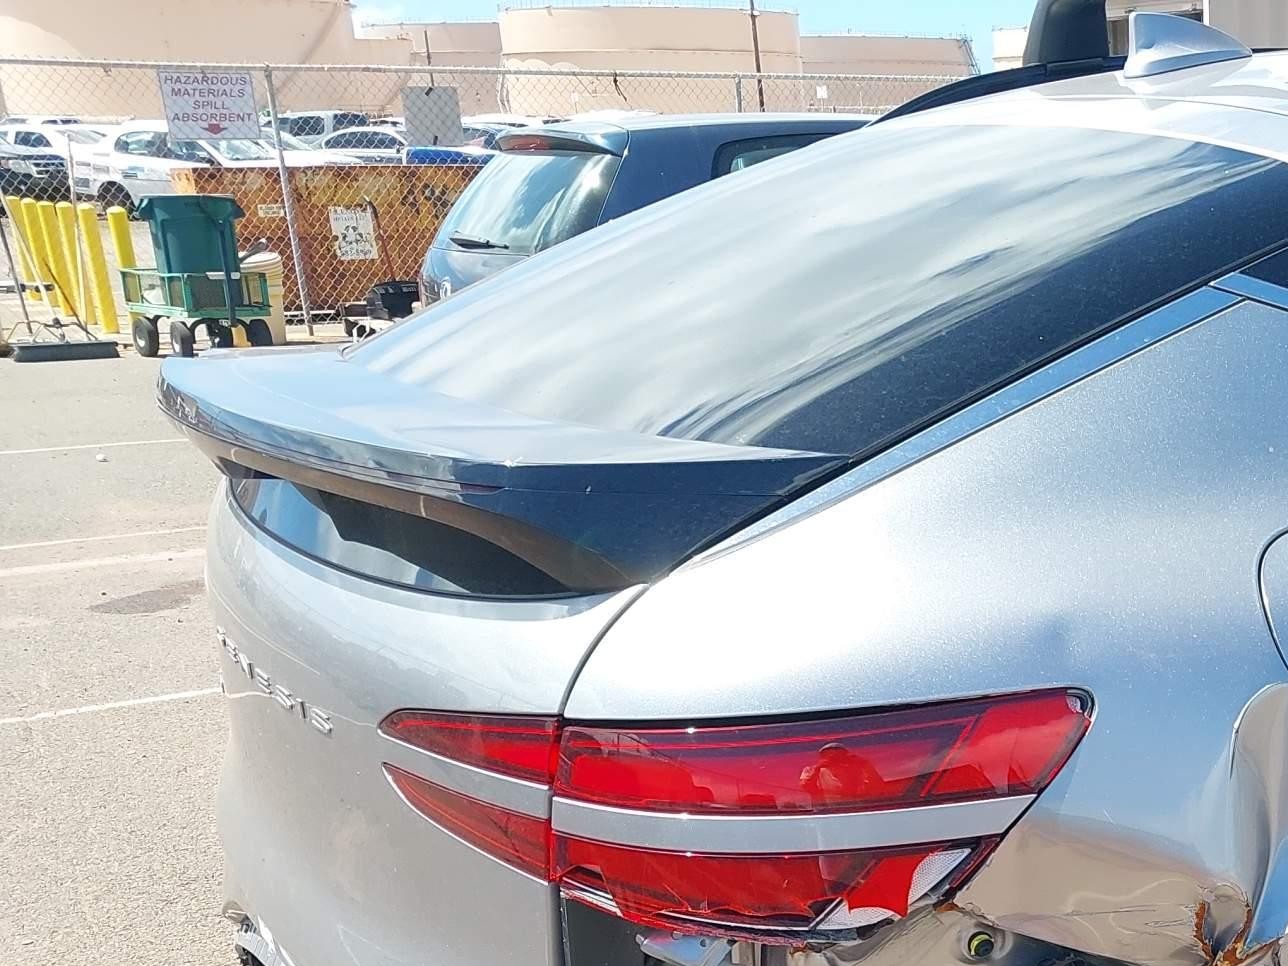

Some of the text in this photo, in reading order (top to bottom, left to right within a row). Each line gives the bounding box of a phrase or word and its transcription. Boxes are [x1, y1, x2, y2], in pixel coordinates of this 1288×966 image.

[164, 75, 247, 86] HAZARDOUS
[171, 88, 245, 98] MATERIALS
[192, 100, 229, 110] SPILL
[172, 112, 252, 122] ABSORBENT
